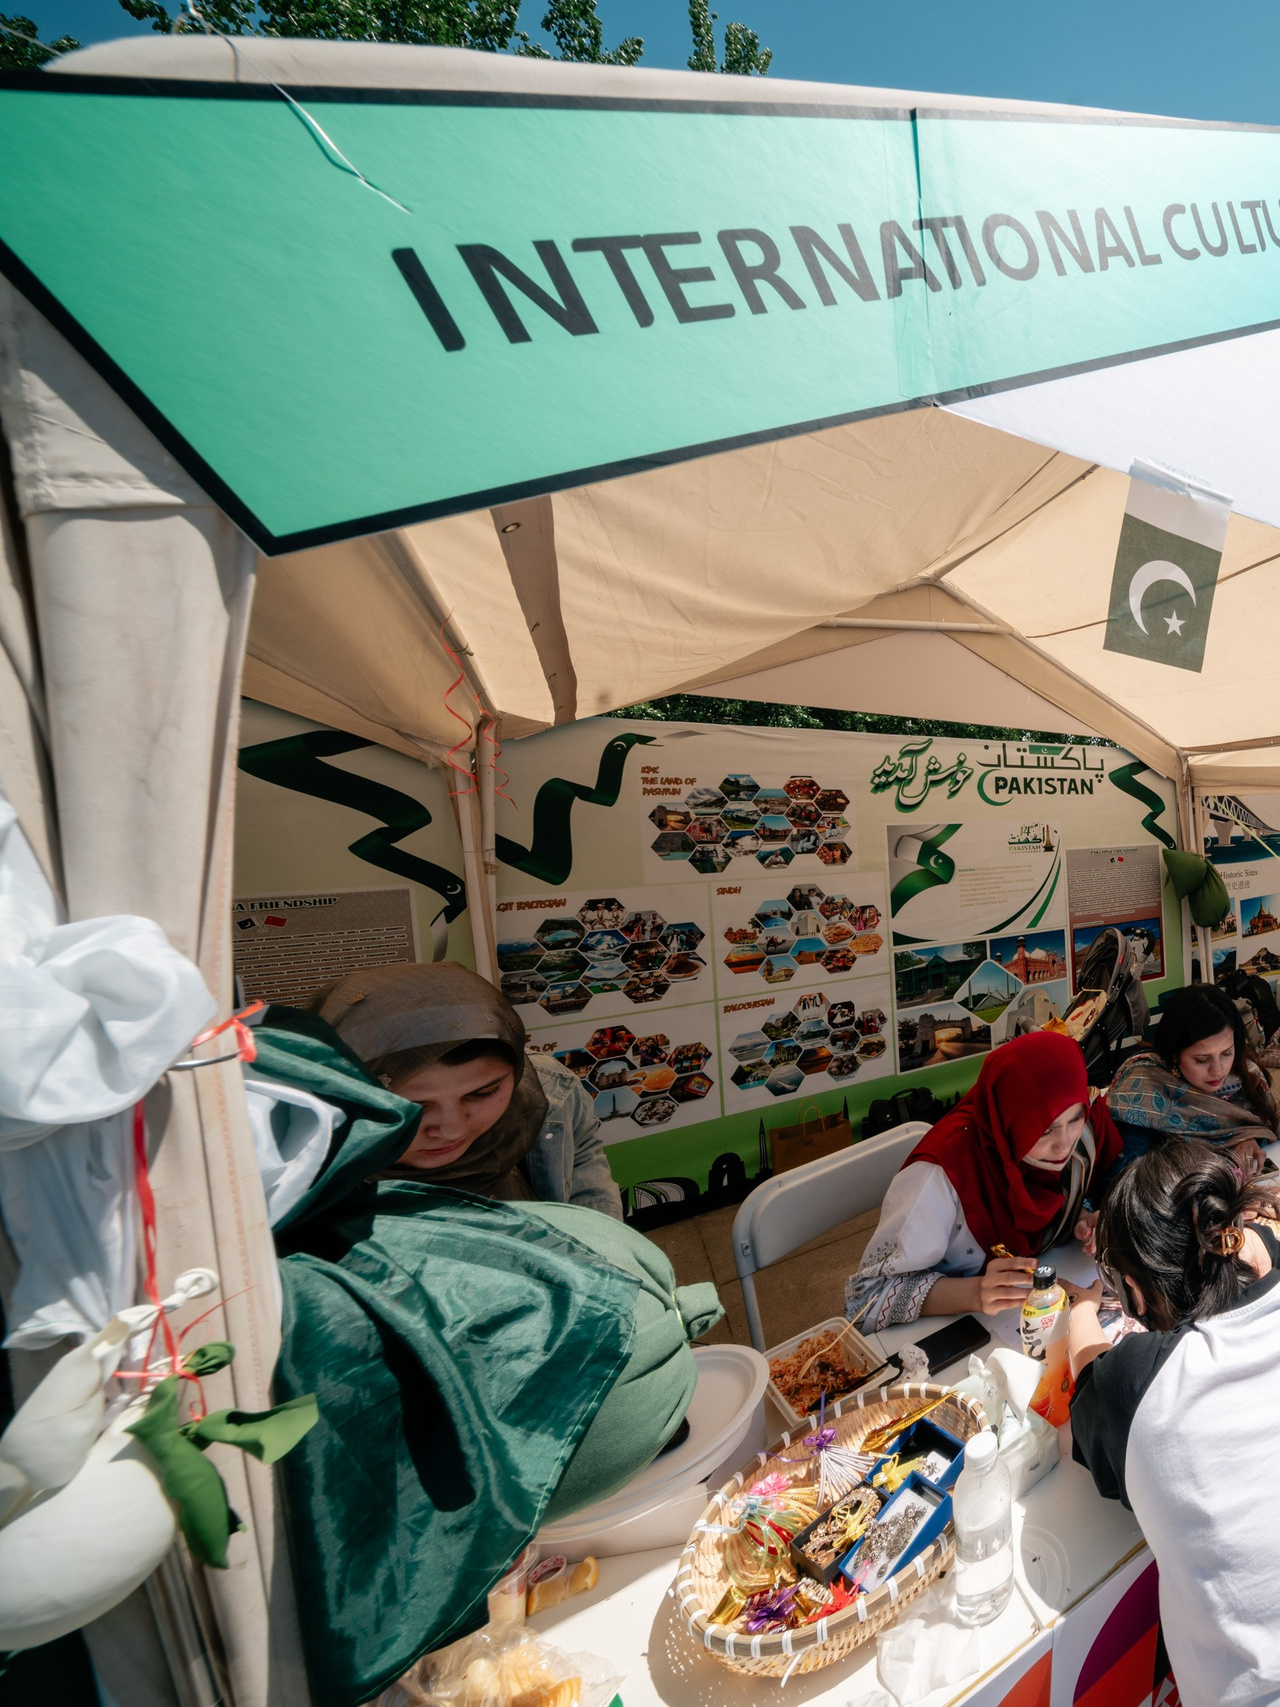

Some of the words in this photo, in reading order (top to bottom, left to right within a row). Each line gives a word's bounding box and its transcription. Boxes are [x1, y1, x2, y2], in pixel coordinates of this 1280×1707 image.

[391, 206, 1163, 353] INTERNATIONAL
[641, 777, 658, 785] THE
[660, 777, 683, 785] LAND
[684, 777, 697, 786] OF
[994, 777, 1094, 795] PAKISTAN
[1220, 870, 1244, 879] Historic
[1244, 869, 1259, 877] Sites
[716, 886, 742, 896] SINDH
[250, 898, 338, 910] FRIENDSHIP
[542, 1042, 558, 1052] OF
